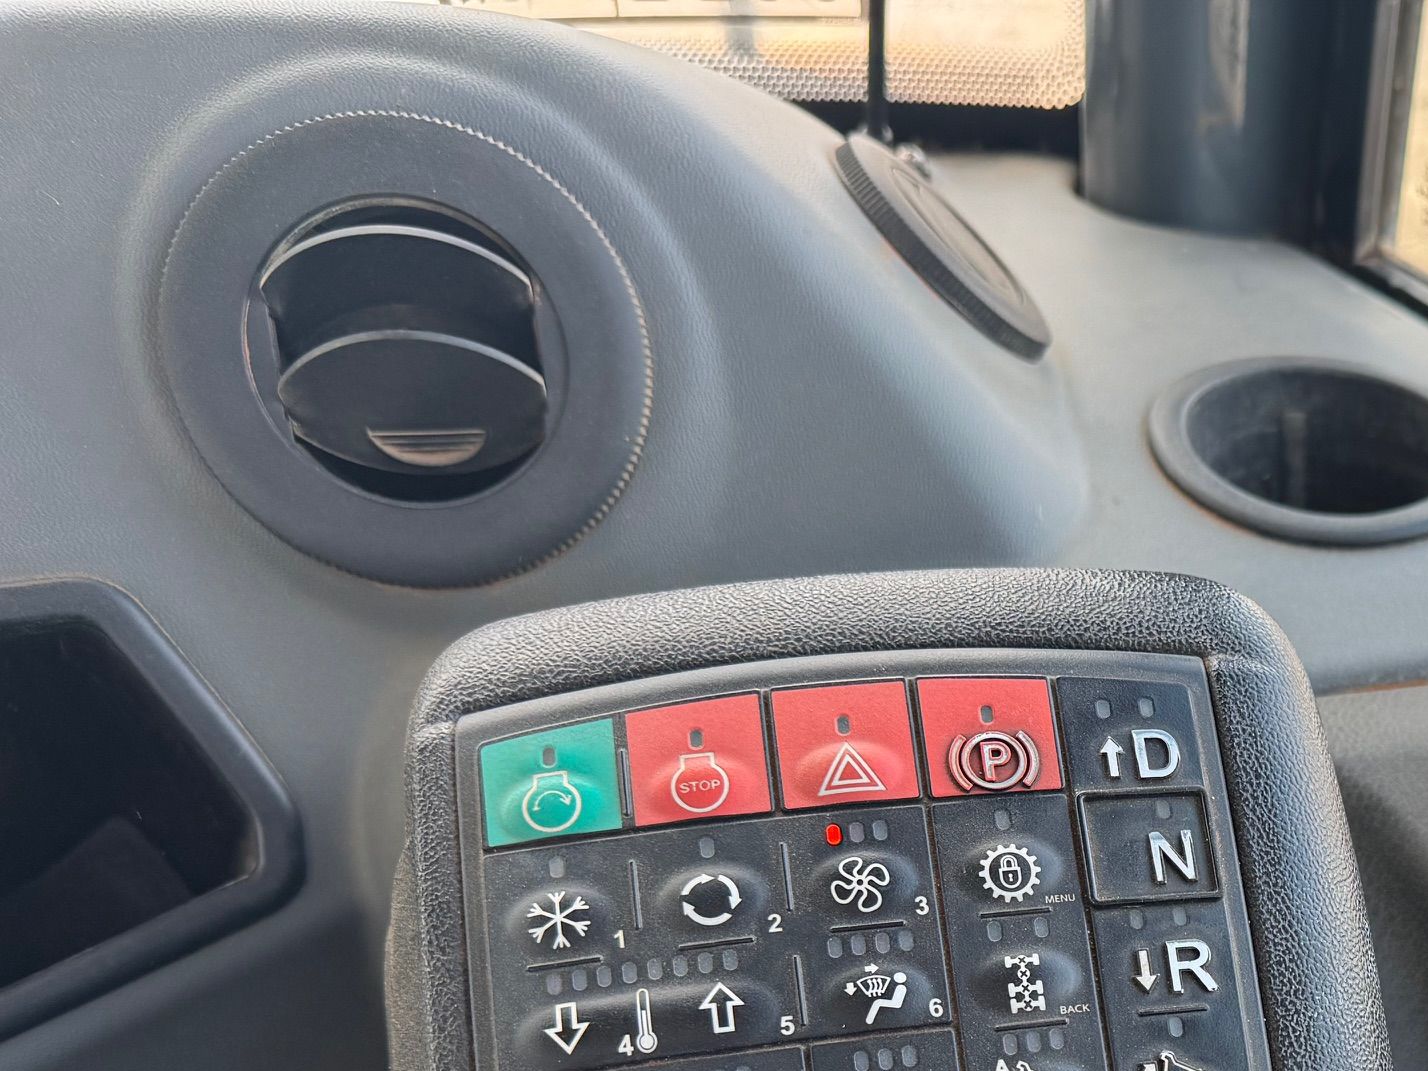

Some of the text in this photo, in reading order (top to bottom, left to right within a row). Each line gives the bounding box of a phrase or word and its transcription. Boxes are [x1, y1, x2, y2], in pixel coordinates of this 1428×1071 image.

[980, 742, 1012, 782] P
[1131, 729, 1181, 779] D
[679, 778, 721, 793] STOP
[1147, 829, 1198, 884] N
[914, 896, 930, 915] 3
[1045, 893, 1076, 904] MENU
[767, 914, 783, 934] 2
[614, 929, 626, 949] 1
[1164, 939, 1219, 994] R
[929, 998, 944, 1018] 6
[1059, 1003, 1091, 1015] BACK
[780, 1016, 795, 1036] 5
[618, 1035, 634, 1056] 4
